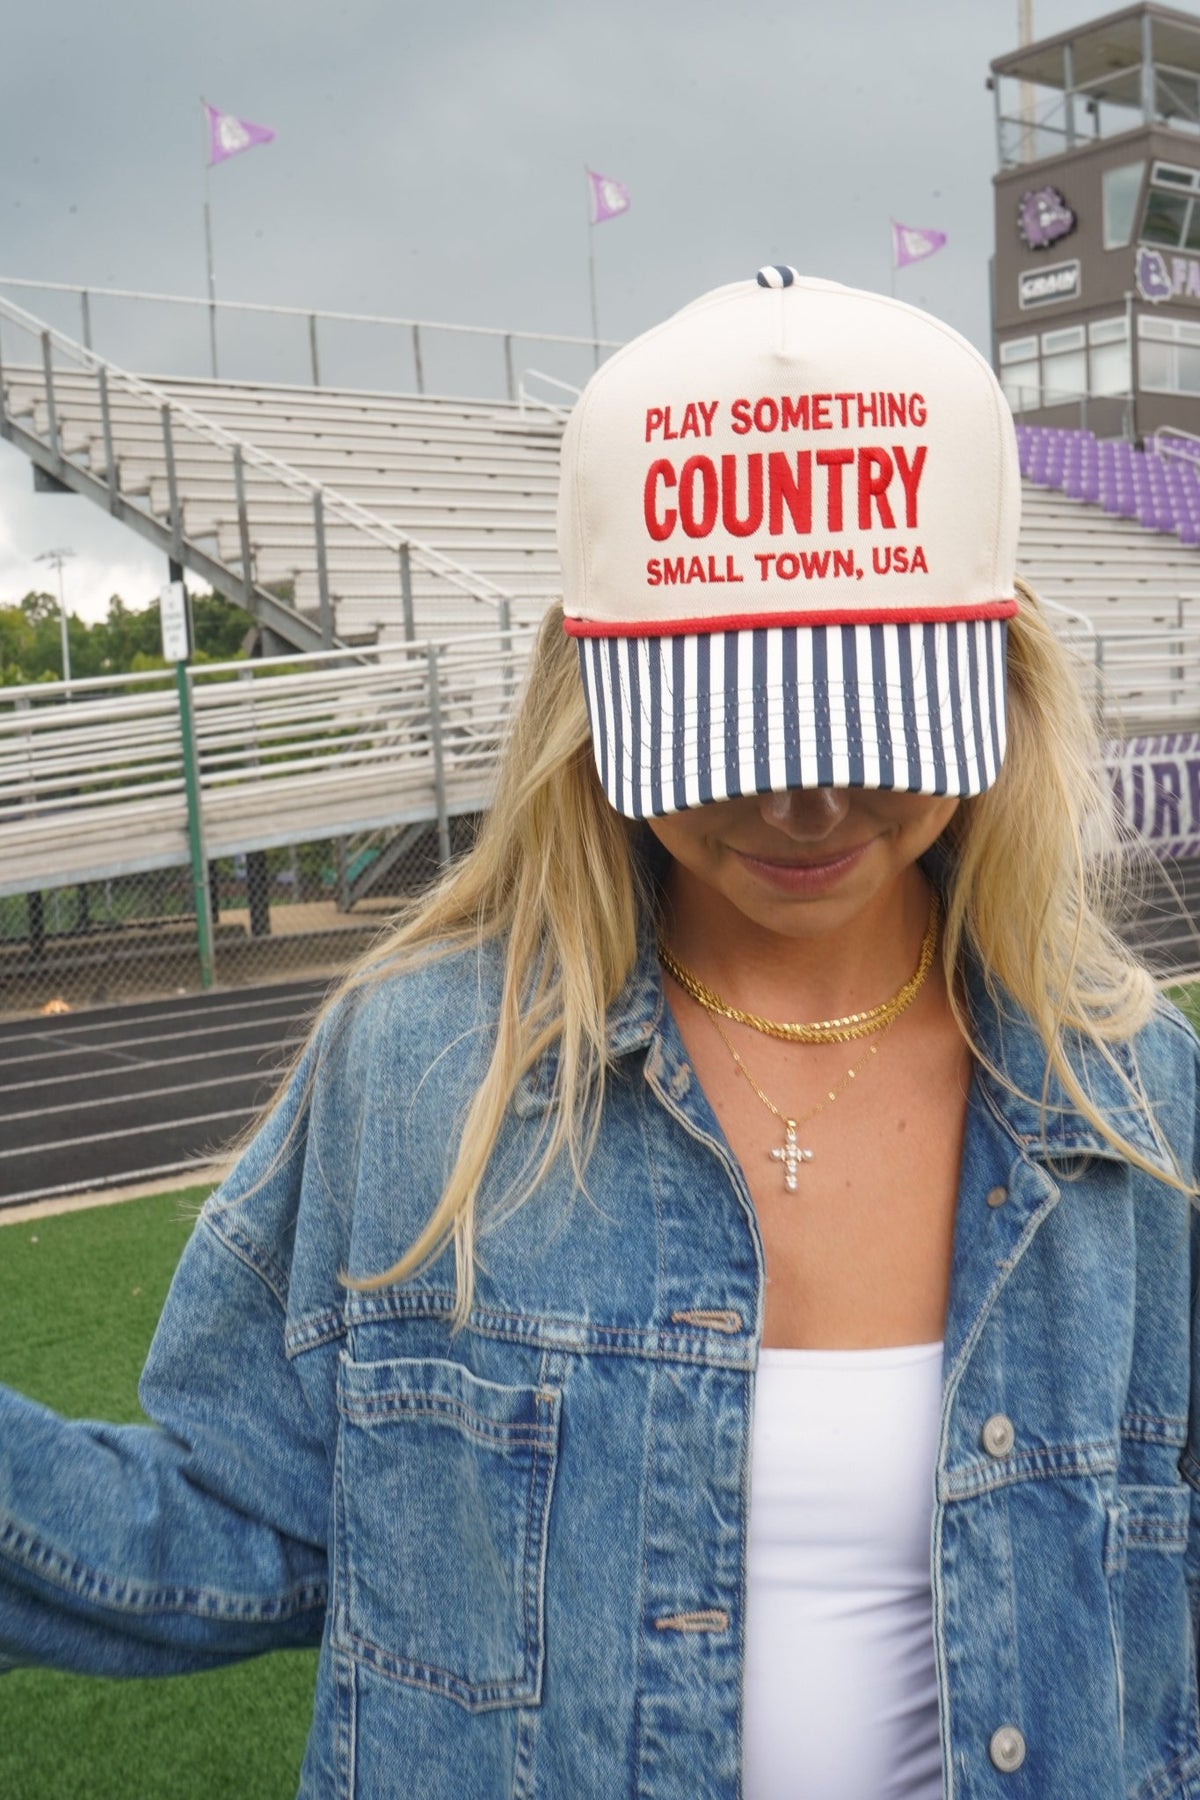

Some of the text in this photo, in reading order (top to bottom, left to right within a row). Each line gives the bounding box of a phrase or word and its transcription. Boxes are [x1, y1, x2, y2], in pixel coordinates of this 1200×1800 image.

[645, 391, 928, 443] PLAY SOMETHING
[644, 445, 928, 541] COUNTRY
[646, 545, 929, 586] SMALL TOWN, USA
